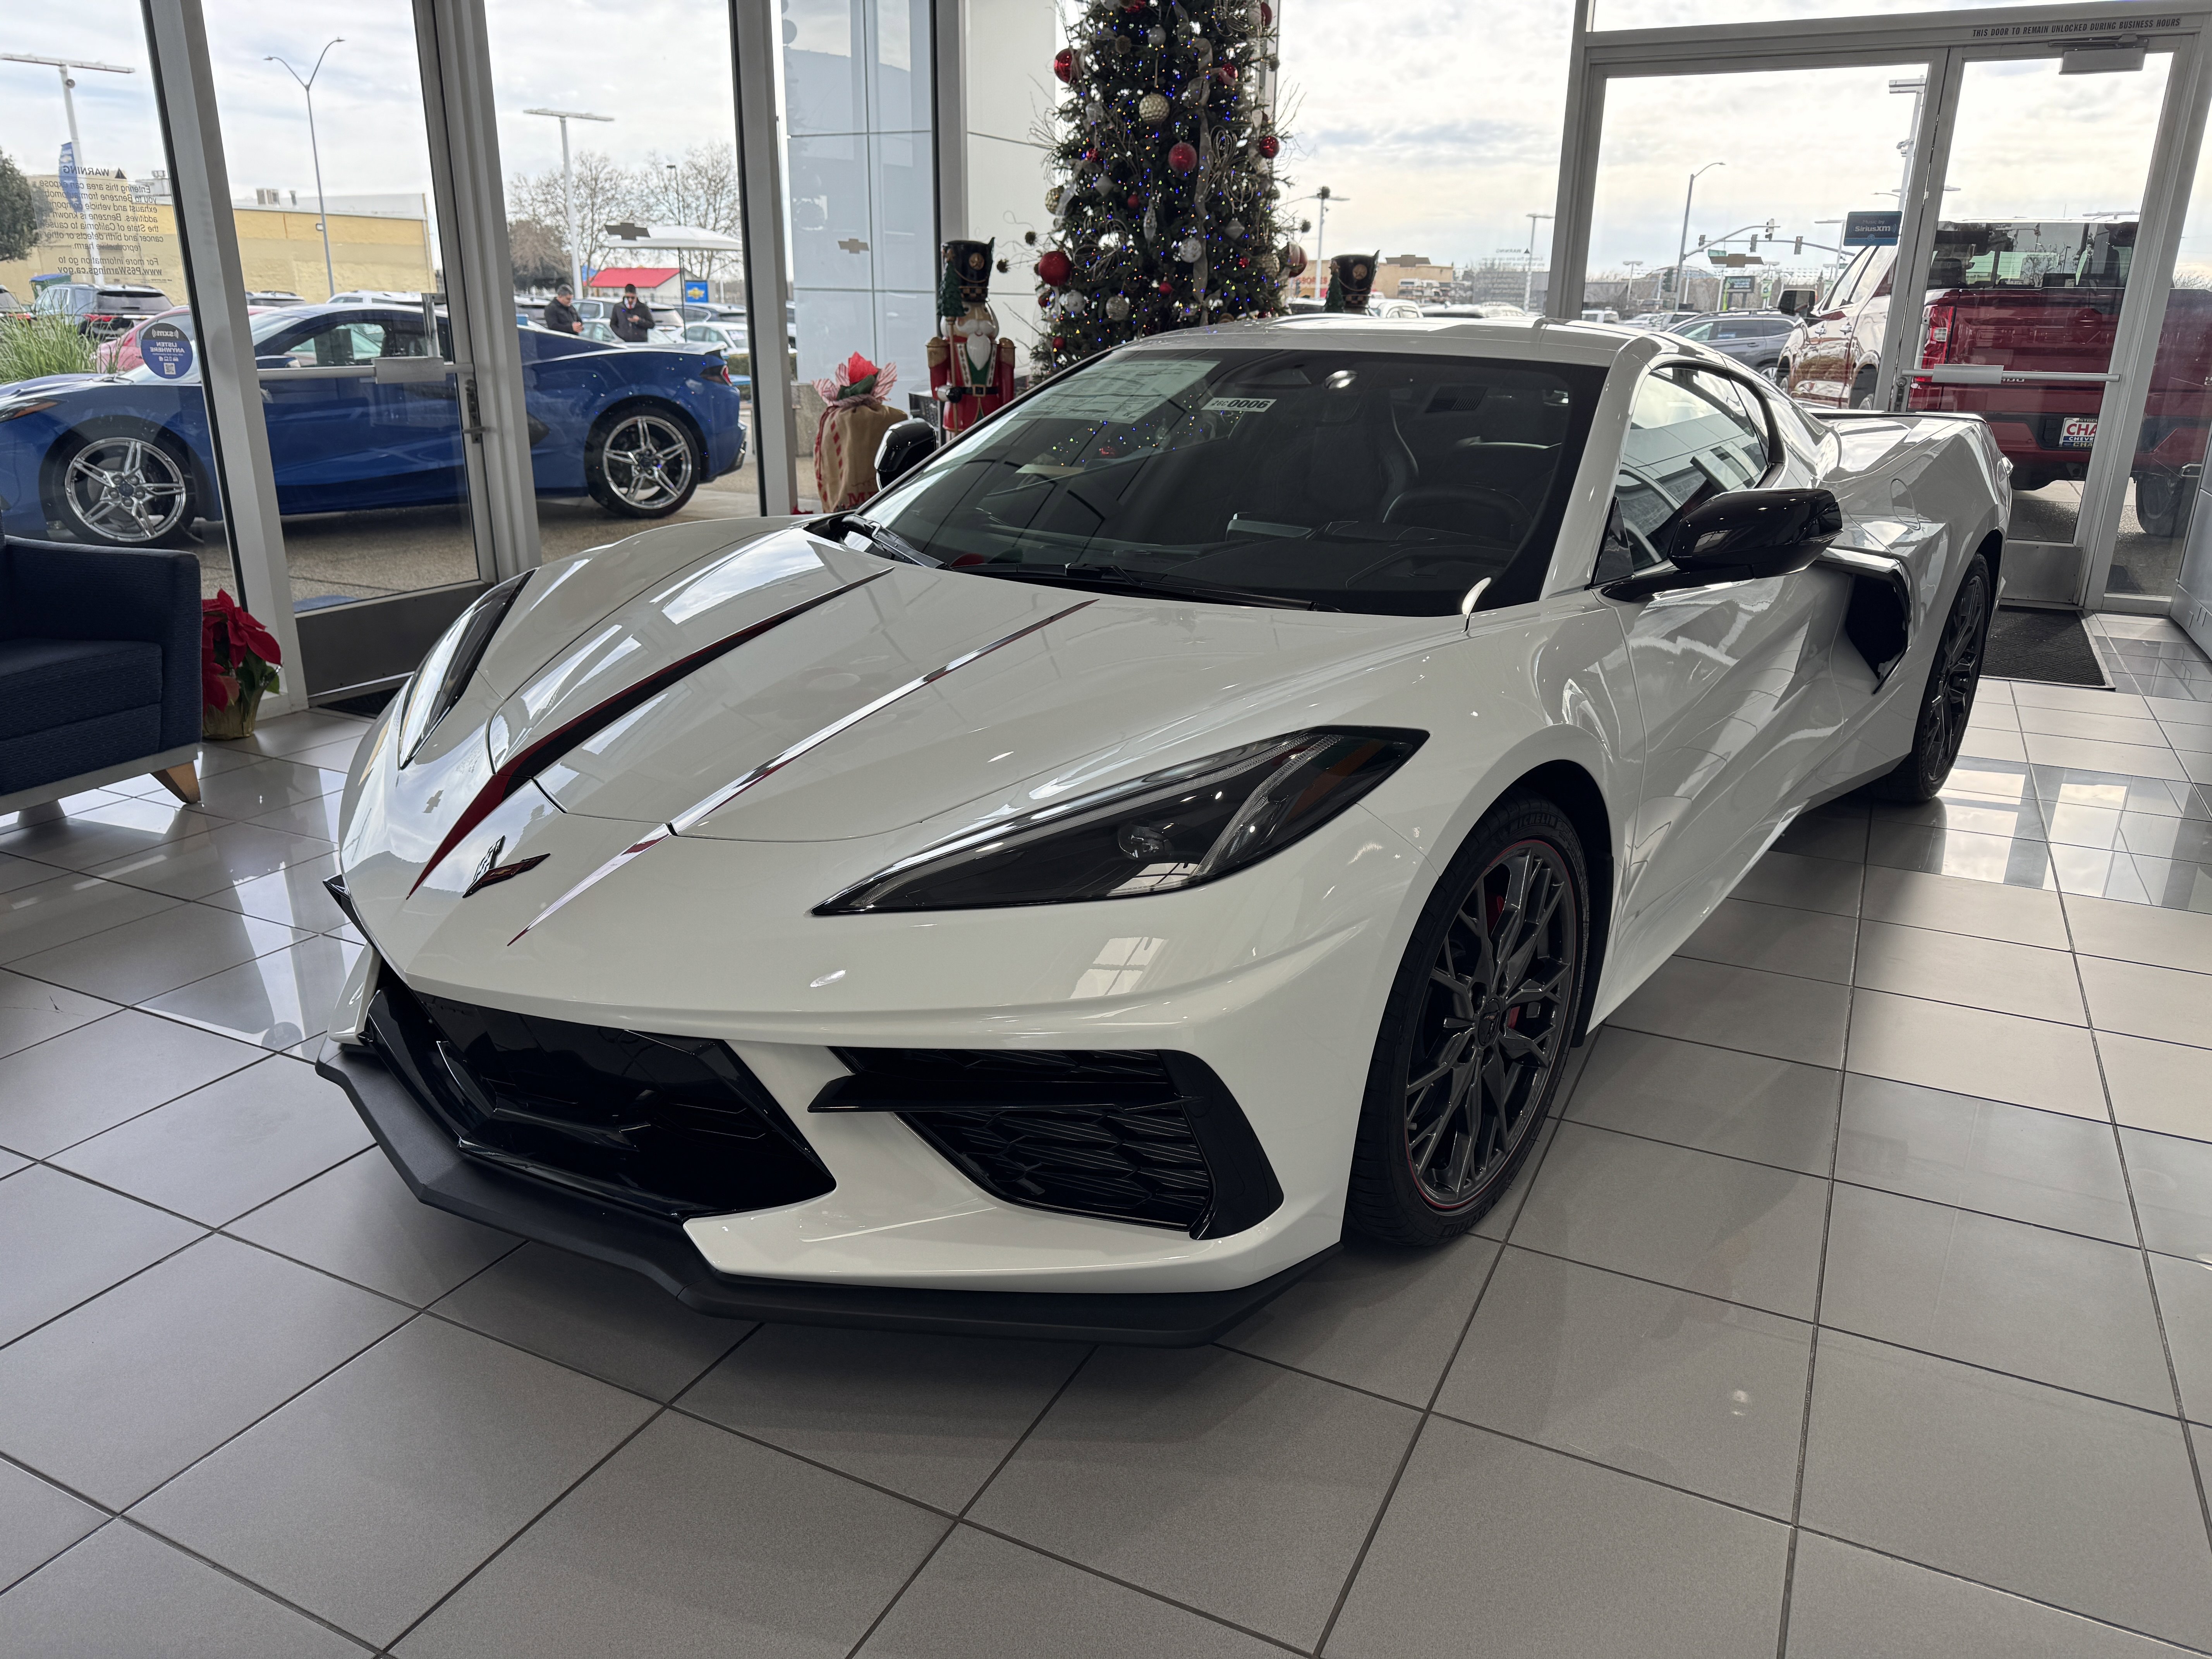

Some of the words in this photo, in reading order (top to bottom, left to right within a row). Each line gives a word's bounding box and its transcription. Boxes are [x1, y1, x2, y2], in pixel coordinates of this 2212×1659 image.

[1991, 28, 2009, 36] DOOR
[2023, 26, 2049, 34] REMAIN
[2052, 24, 2087, 33] UNLOCKED
[2090, 22, 2116, 30] DURING
[2119, 20, 2153, 29] BUSINESS
[2156, 18, 2180, 27] HOURS
[2066, 424, 2097, 436] CHA
[1510, 813, 1556, 834] MICHELIN
